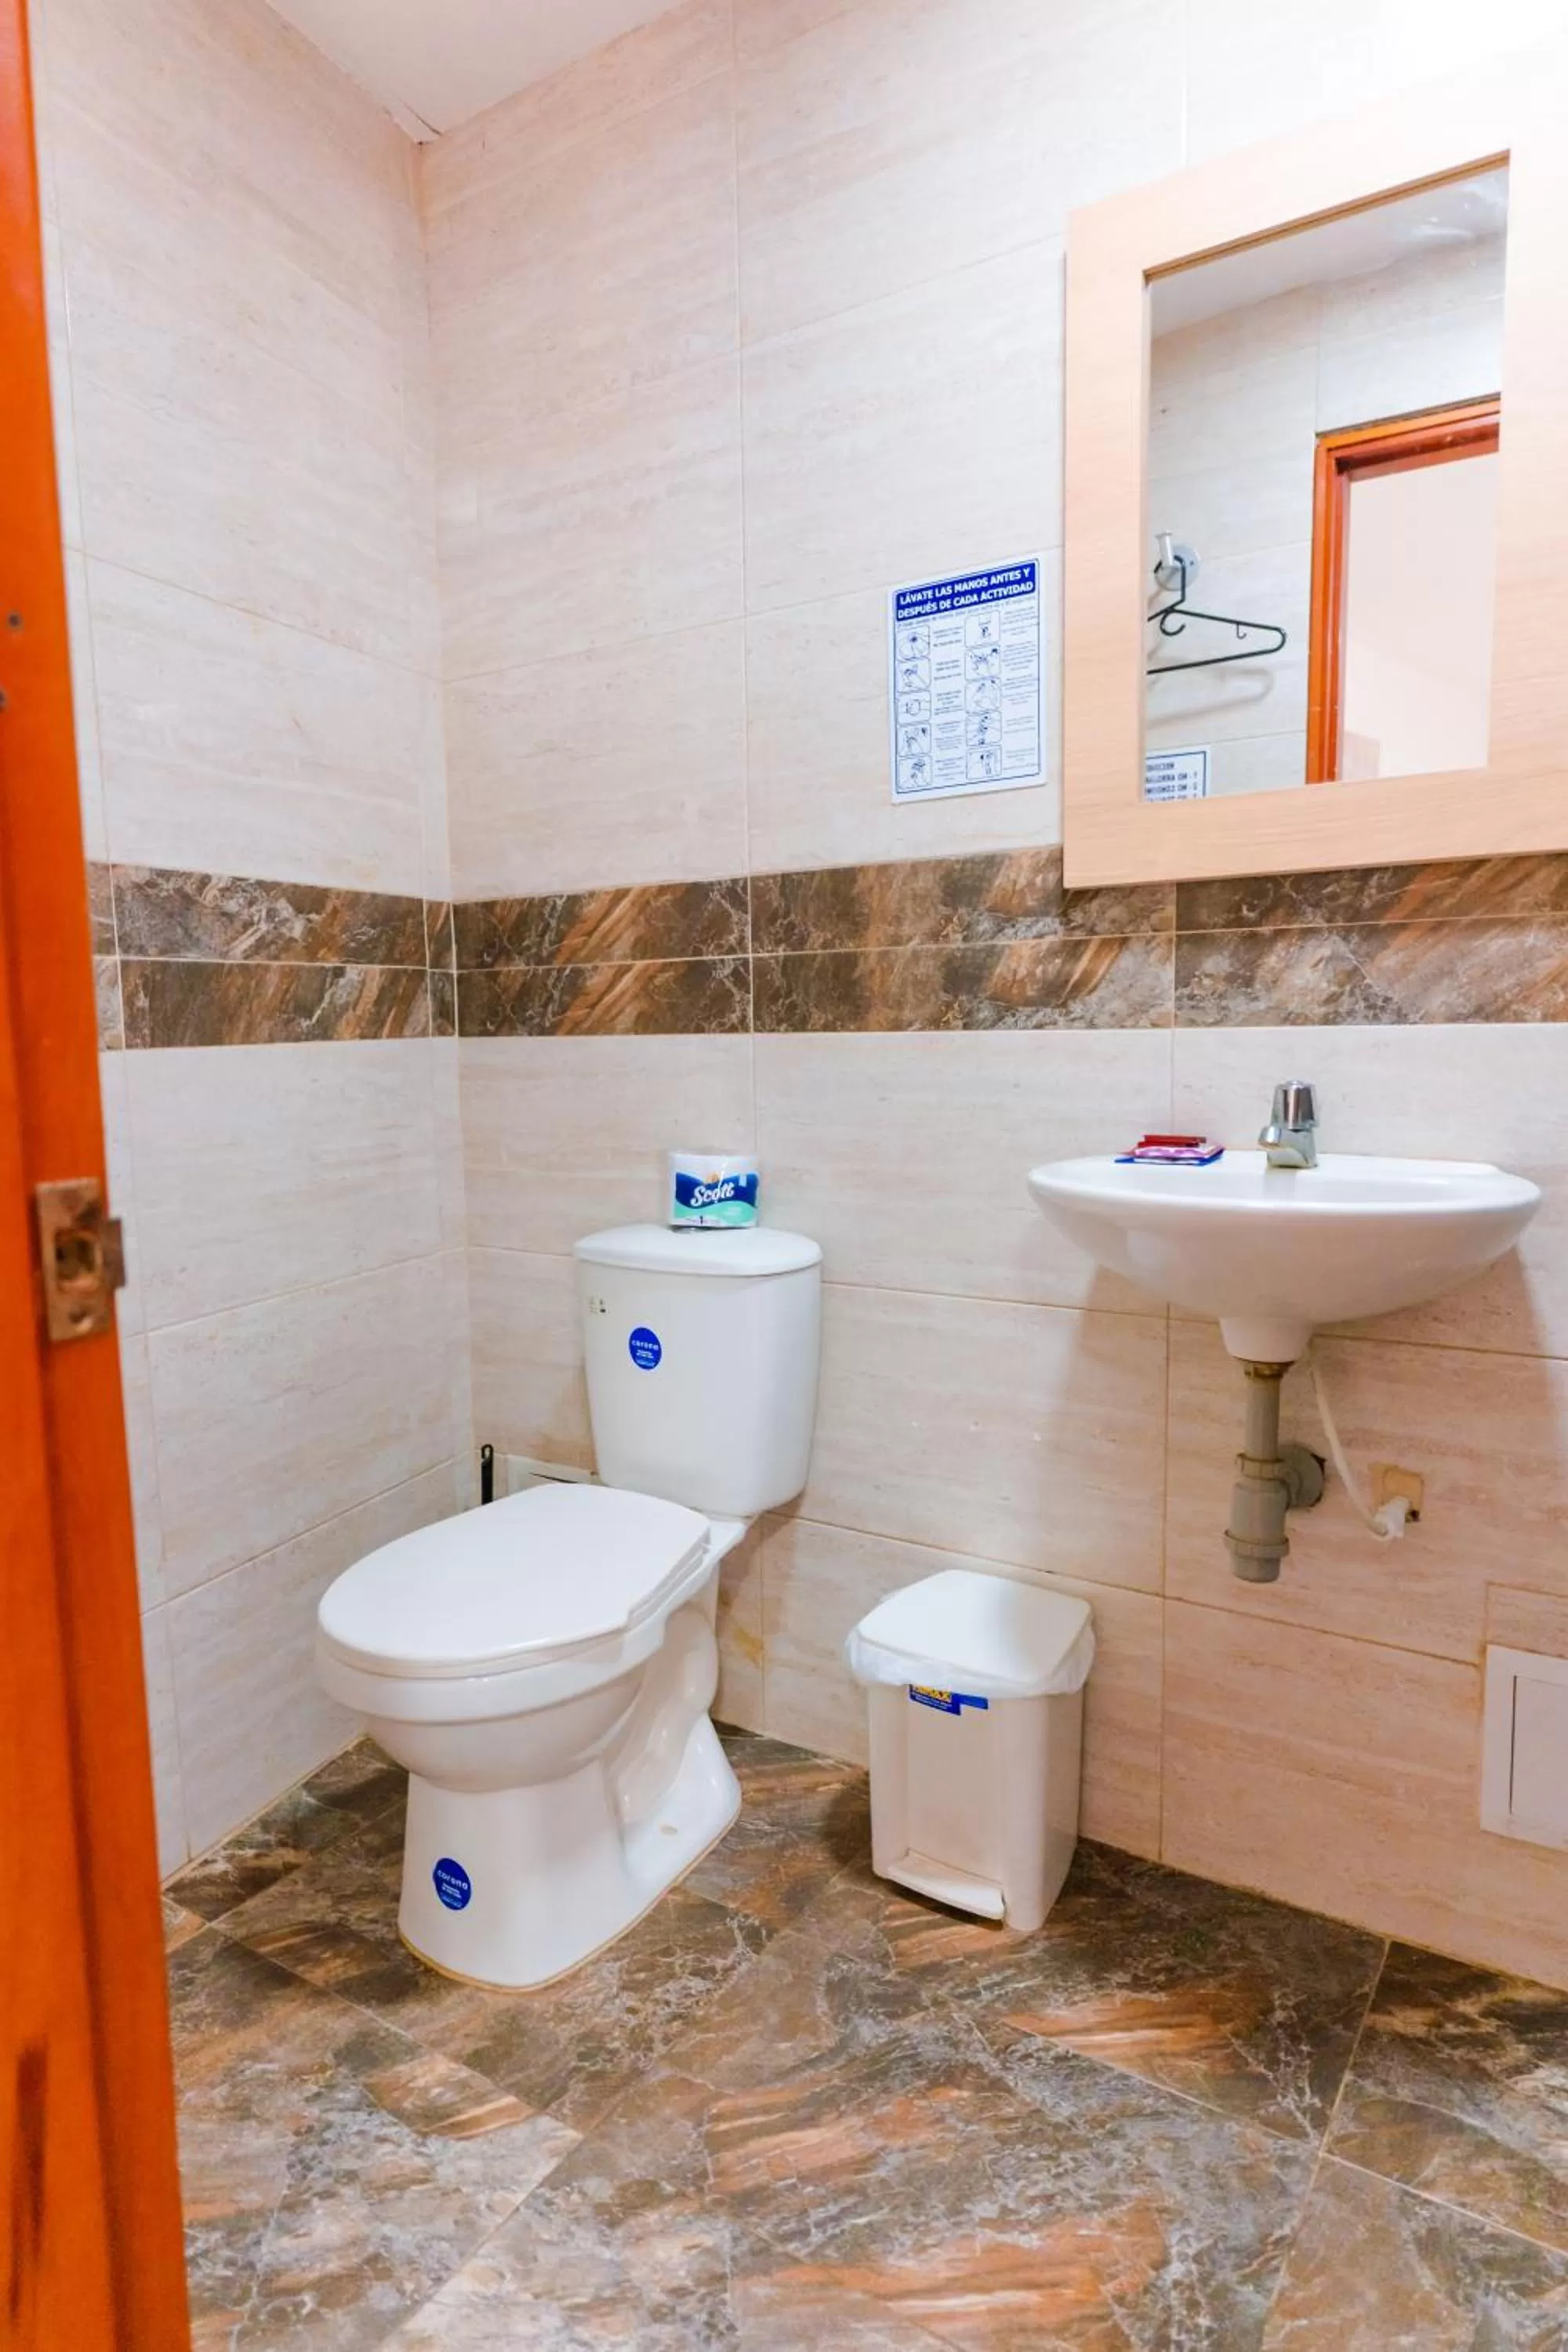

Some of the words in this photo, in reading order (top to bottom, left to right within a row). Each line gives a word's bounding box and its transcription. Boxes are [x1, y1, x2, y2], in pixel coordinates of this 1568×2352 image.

[898, 602, 938, 619] DESPUÉS
[938, 599, 952, 609] DE
[953, 593, 979, 607] CADA
[980, 581, 1034, 601] ACTIVIDAD
[900, 590, 933, 604] LÁVATE
[935, 585, 953, 597] LAS
[954, 578, 989, 592] MANOS
[990, 572, 1022, 586] ANTES
[1022, 567, 1031, 578] Y
[690, 1181, 735, 1207] Scott
